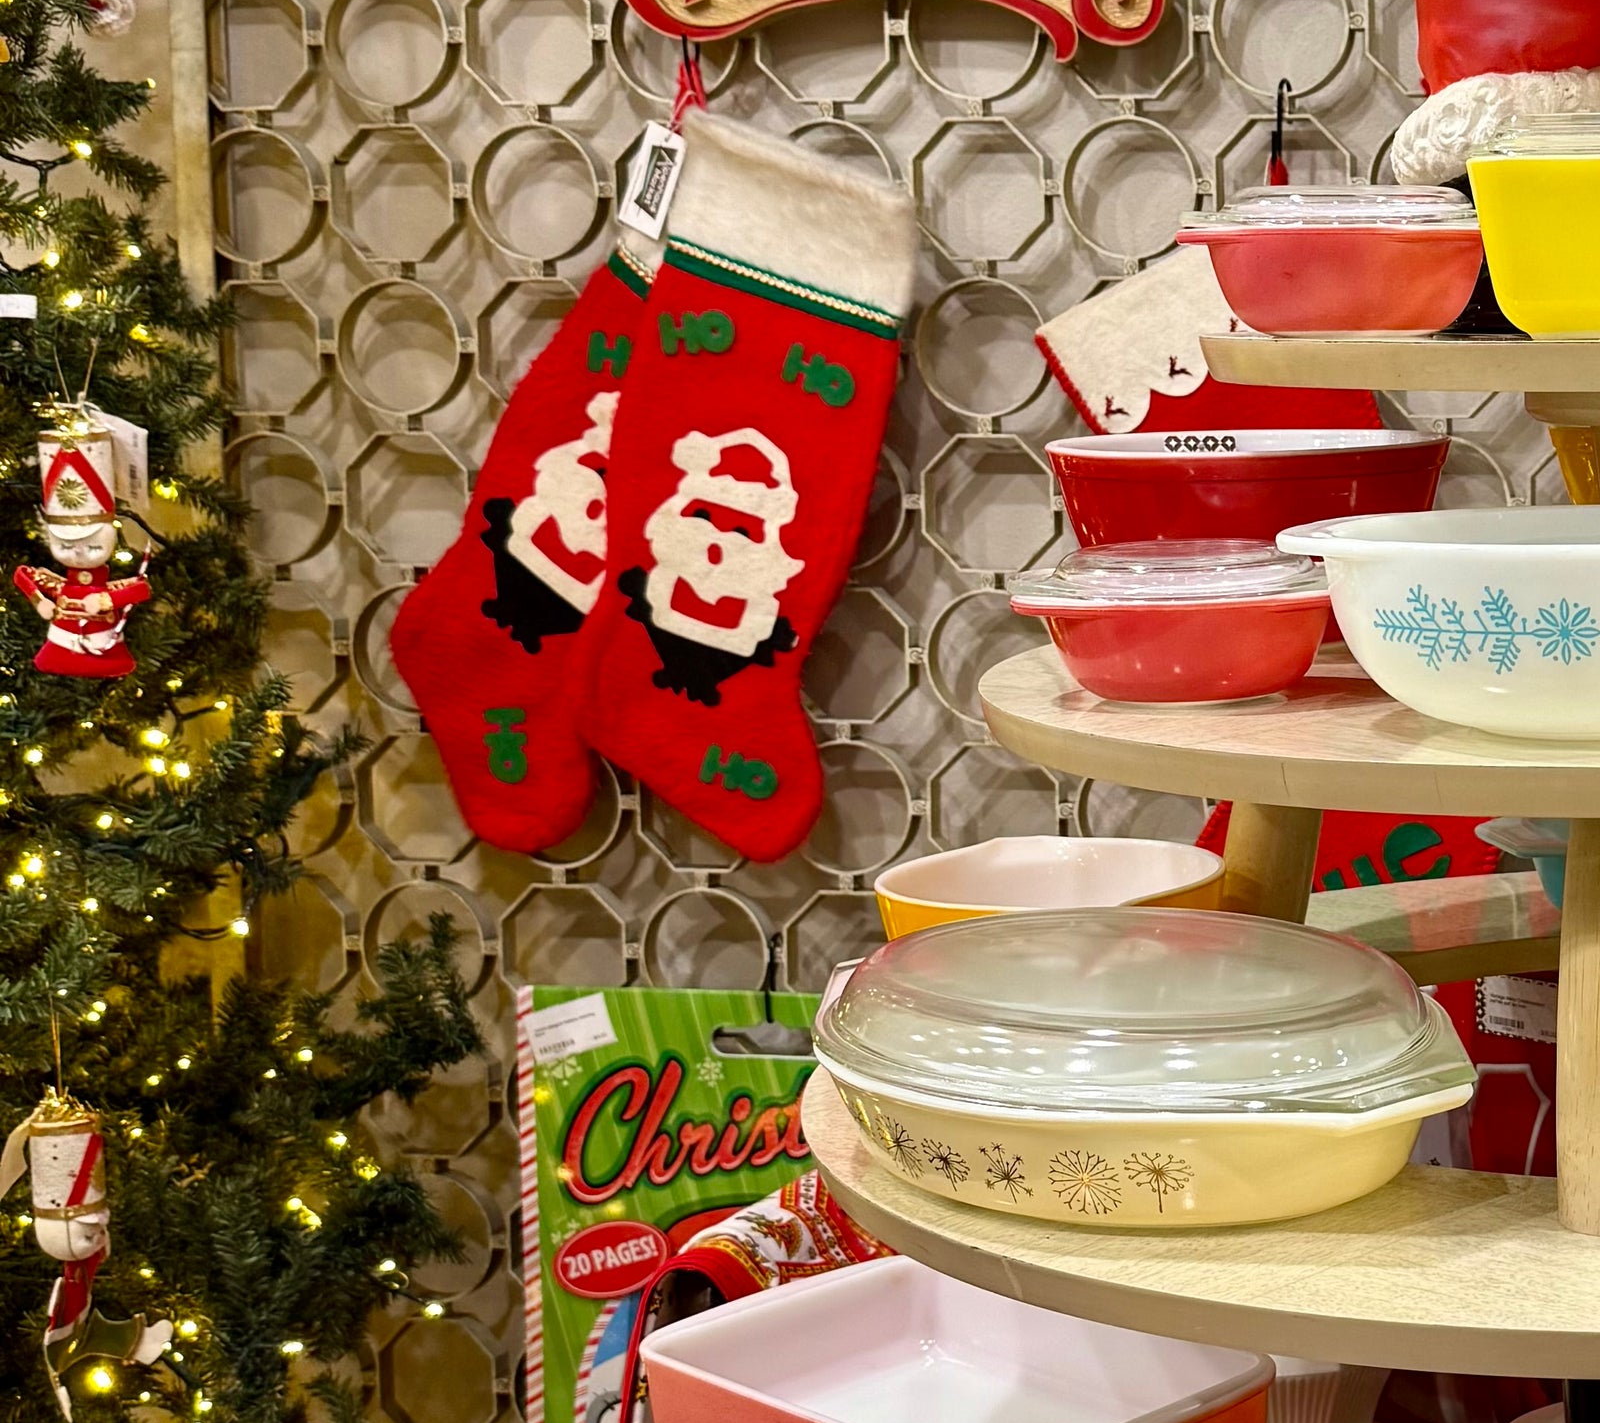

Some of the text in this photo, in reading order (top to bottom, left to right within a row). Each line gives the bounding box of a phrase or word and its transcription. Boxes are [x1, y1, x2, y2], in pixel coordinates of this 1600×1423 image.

[588, 330, 632, 378] H
[659, 310, 734, 355] HO
[781, 342, 855, 407] HO
[700, 744, 779, 800] HO
[563, 1234, 659, 1279] 20 PAGES!
